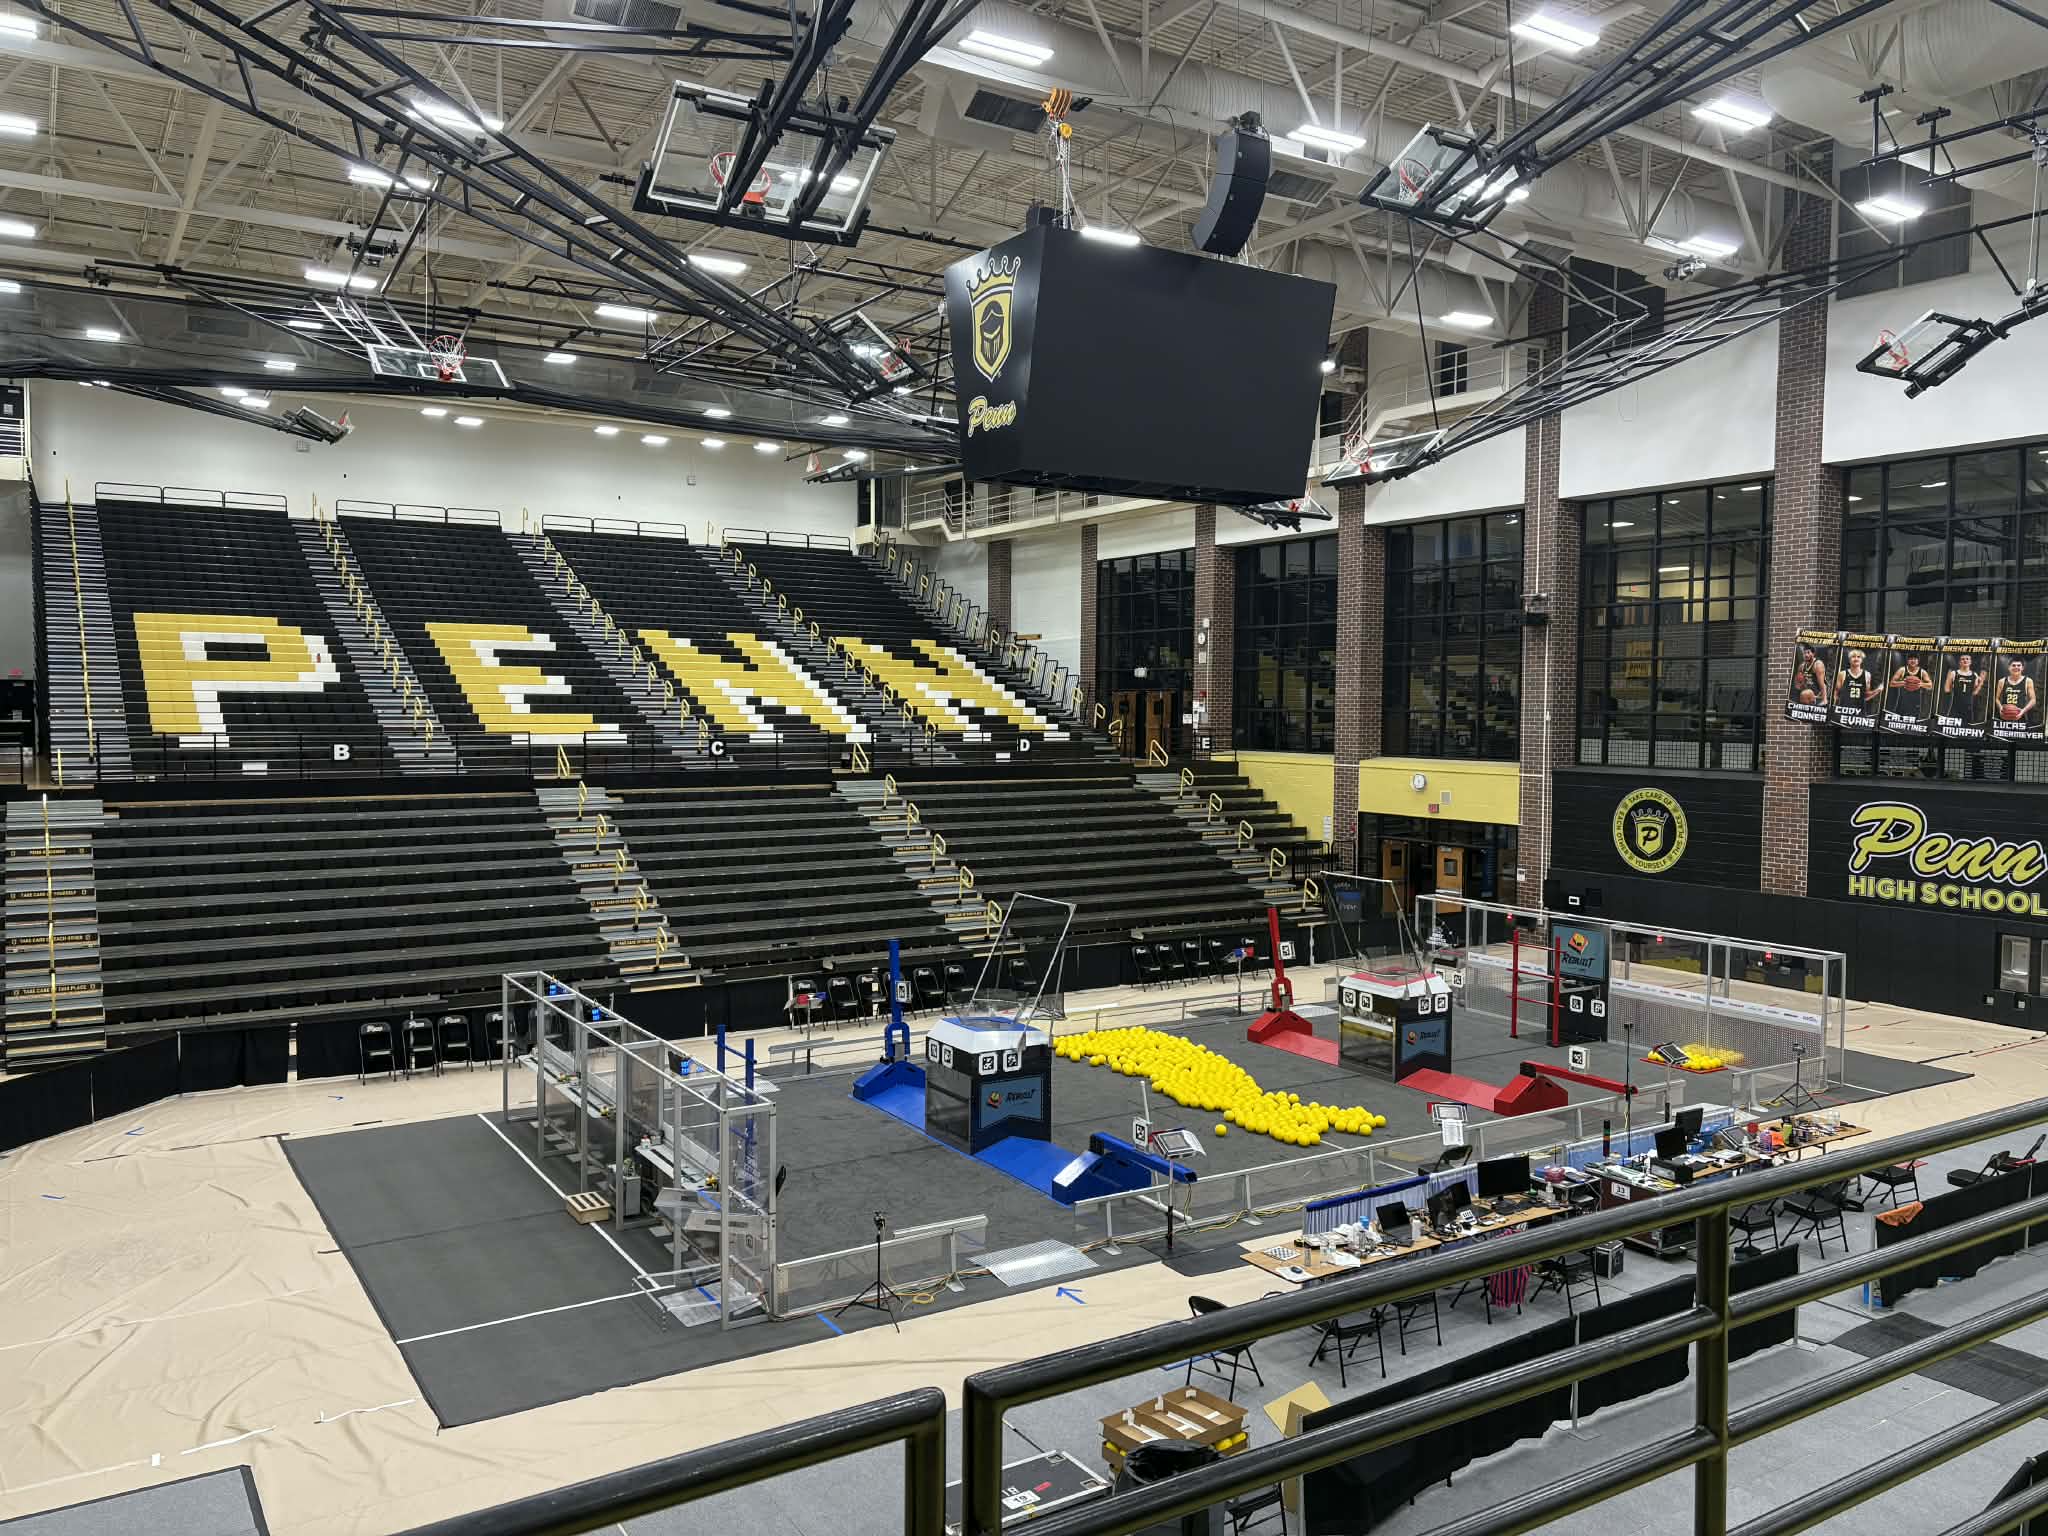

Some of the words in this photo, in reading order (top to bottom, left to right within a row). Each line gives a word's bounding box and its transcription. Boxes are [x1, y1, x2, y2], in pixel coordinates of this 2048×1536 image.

[967, 395, 1017, 438] Penn
[1849, 687, 1861, 698] 23
[2006, 694, 2018, 704] 22
[1787, 703, 1828, 713] CHRISTIAN
[1835, 706, 1861, 715] CODY
[1791, 710, 1827, 722] BONNER
[1840, 715, 1876, 728] EVANS
[1884, 713, 1917, 723] CALEB
[1937, 716, 1963, 727] BEN
[1888, 722, 1928, 733] MARTINEZ
[1942, 726, 1985, 737] MURPHY
[1993, 721, 2027, 730] LUCAS
[1993, 730, 2044, 739] OBERMEYER
[711, 741, 724, 755] C
[1020, 738, 1030, 751] D
[1202, 737, 1211, 749] E
[334, 744, 350, 760] B
[1645, 792, 1662, 800] CARE
[1663, 797, 1673, 806] OF
[1641, 826, 1659, 846] P
[1848, 800, 2048, 887] Penn
[1848, 874, 1917, 902] HIGH
[1919, 881, 2048, 917] SCHOOL
